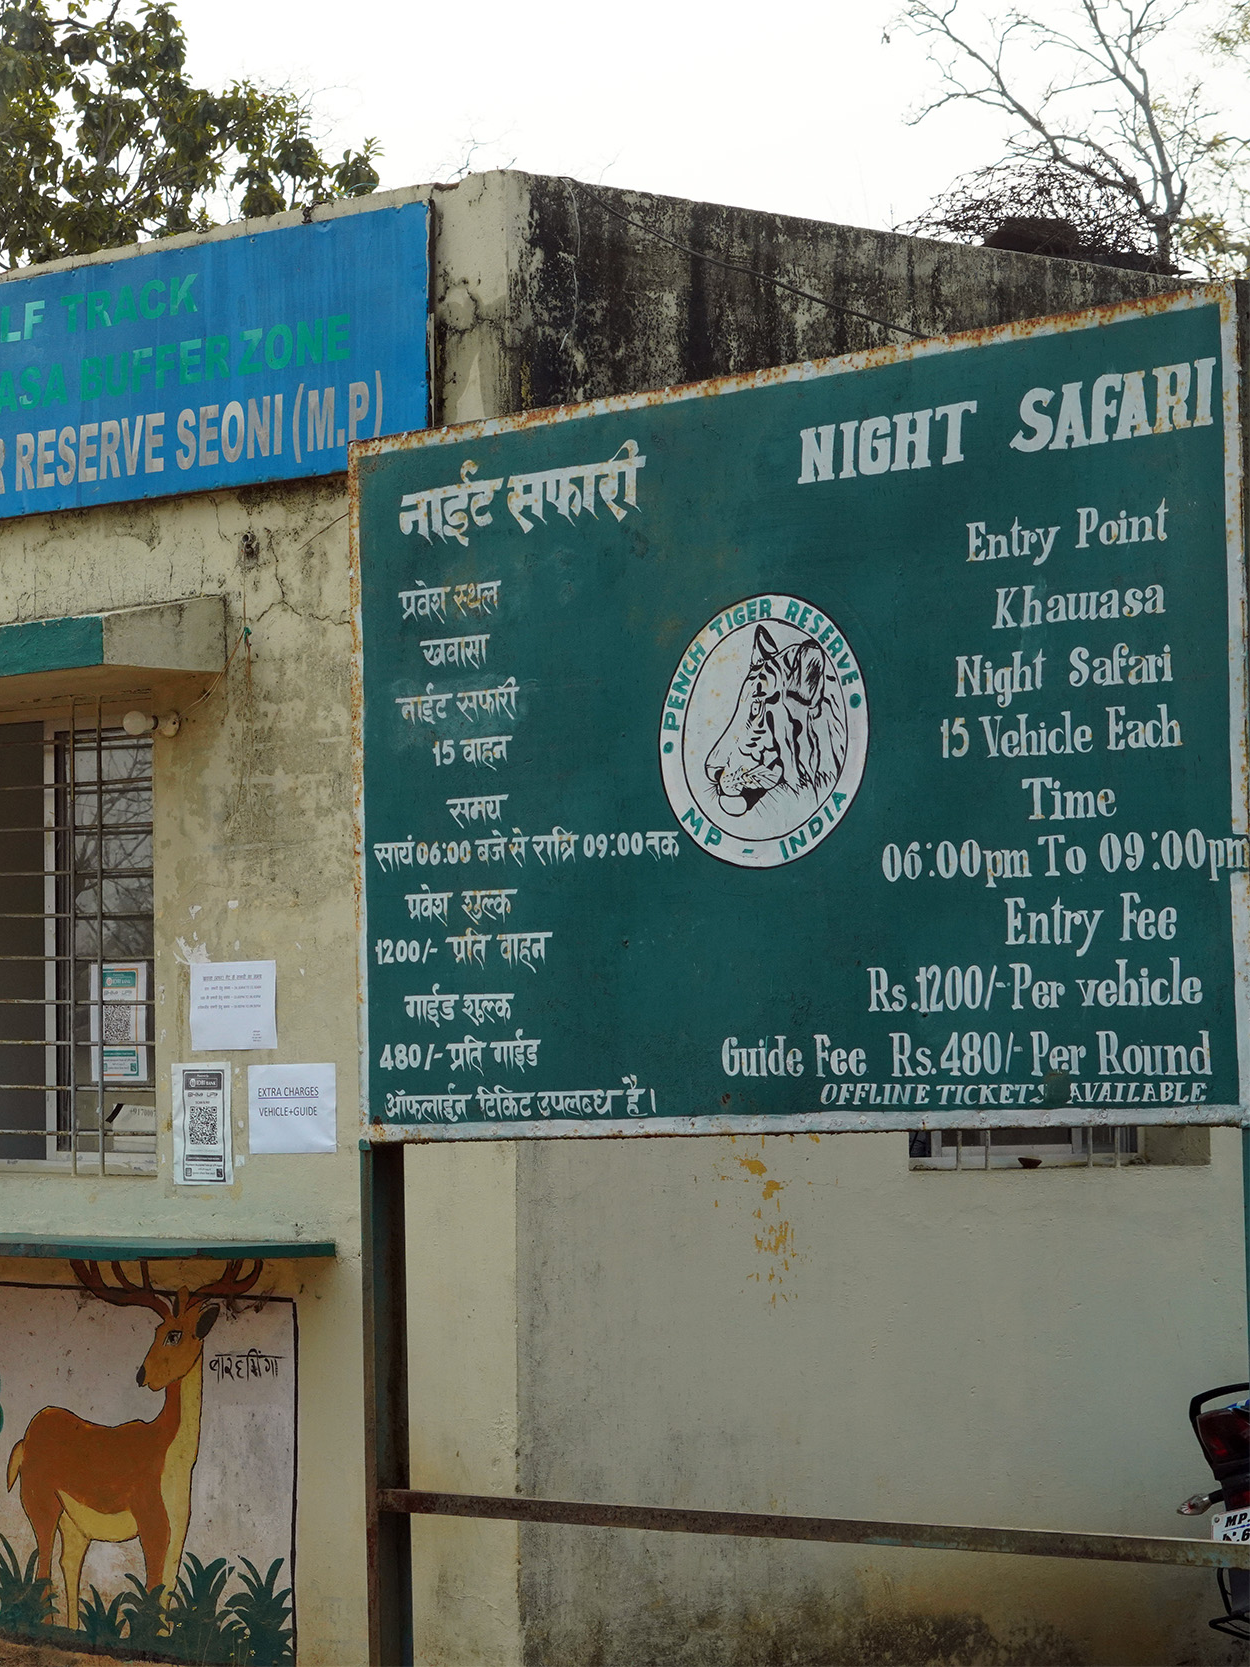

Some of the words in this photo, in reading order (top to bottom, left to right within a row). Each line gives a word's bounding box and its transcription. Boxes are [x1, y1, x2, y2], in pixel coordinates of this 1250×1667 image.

[59, 273, 199, 334] TRACK
[81, 335, 230, 401] BUFFER
[238, 313, 351, 376] ZONE
[15, 412, 165, 492] RESERVE
[175, 393, 283, 471] SEONI
[293, 370, 384, 463] (M.P)
[797, 400, 977, 485] NIGHT
[1009, 357, 1217, 452] SAFARI
[399, 459, 503, 547] नाईट
[507, 438, 647, 534] सफारी
[965, 516, 1060, 566] Entry
[1074, 498, 1169, 549] Point
[398, 579, 450, 624] प्रवेश
[453, 580, 501, 616] स्थल
[420, 633, 490, 669] खवासा
[665, 641, 706, 731] PENCH
[708, 598, 772, 639] TIGER
[784, 601, 859, 686] RESERVE
[954, 652, 1047, 708] Night
[1068, 642, 1173, 688] Safari
[395, 682, 453, 725] नाईट
[456, 676, 520, 723] सफारी
[432, 740, 455, 767] 15
[459, 734, 513, 771] वाहन
[940, 719, 970, 759] 15
[978, 712, 1093, 760] Vehicle
[1106, 704, 1183, 751] Each
[446, 794, 509, 829] समय
[1021, 777, 1117, 822] Time
[373, 834, 415, 873] सायं
[417, 841, 472, 866] 06:00
[474, 829, 508, 865] बजे
[509, 827, 530, 867] से
[532, 826, 579, 866] रात्रि
[583, 832, 644, 859] 09:00
[645, 830, 679, 863] तक
[681, 807, 722, 848] MP
[779, 790, 847, 862] INDIA
[882, 839, 1033, 888] 06:00pm
[1037, 834, 1087, 877] To
[1099, 828, 1249, 882] 09:00pm
[404, 884, 453, 927] प्रवेश
[461, 888, 518, 926] शुल्क
[1004, 897, 1104, 957] Entry
[1119, 892, 1178, 942] Fee
[375, 938, 438, 966] 1200/-
[445, 927, 492, 970] प्रति
[497, 931, 553, 973] वाहन
[404, 983, 459, 1028] गाईड
[463, 993, 514, 1026] शुल्क
[1008, 962, 1065, 1011] Per
[1074, 956, 1203, 1008] vehicle
[379, 1042, 443, 1071] 480/-
[445, 1034, 488, 1076] प्रति
[489, 1028, 542, 1074] गाईड
[721, 1035, 804, 1080] Guide
[814, 1034, 868, 1079] Fee
[890, 1031, 1023, 1079] Rs.480/-
[1029, 1031, 1087, 1078] Per
[1095, 1030, 1213, 1078] Round
[257, 1087, 282, 1098] EXTRA
[283, 1086, 319, 1097] CHARGES
[258, 1106, 318, 1117] VEHICLE+GUIDE
[474, 1085, 536, 1120] टिकिट
[536, 1088, 623, 1117] उपलब्ध
[820, 1082, 930, 1106] OFFLINE
[1067, 1082, 1208, 1105] AVAILABLE
